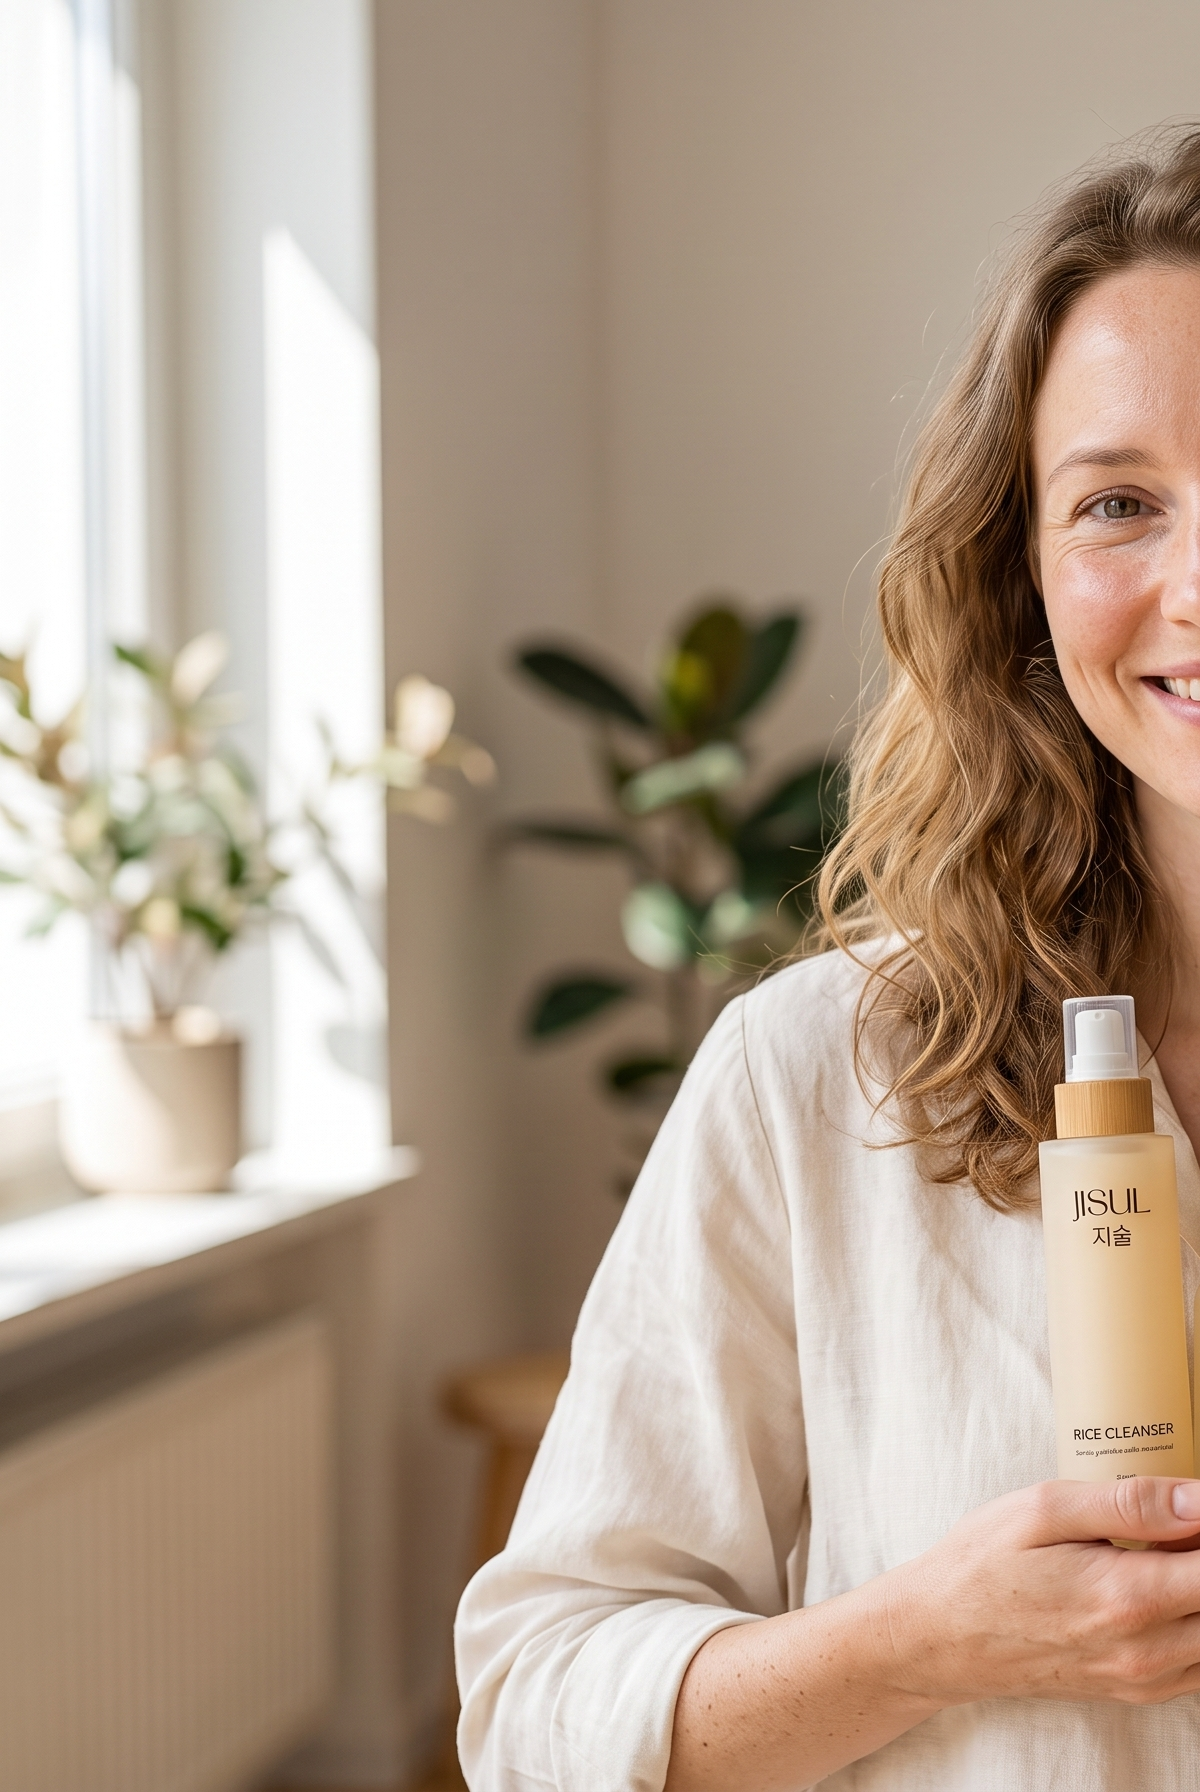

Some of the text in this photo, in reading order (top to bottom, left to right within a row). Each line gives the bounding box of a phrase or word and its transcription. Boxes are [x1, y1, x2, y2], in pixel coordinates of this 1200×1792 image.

[1072, 1187, 1151, 1222] JISUL
[1092, 1224, 1132, 1247] 지술
[1073, 1422, 1174, 1441] RICE CLEANSER
